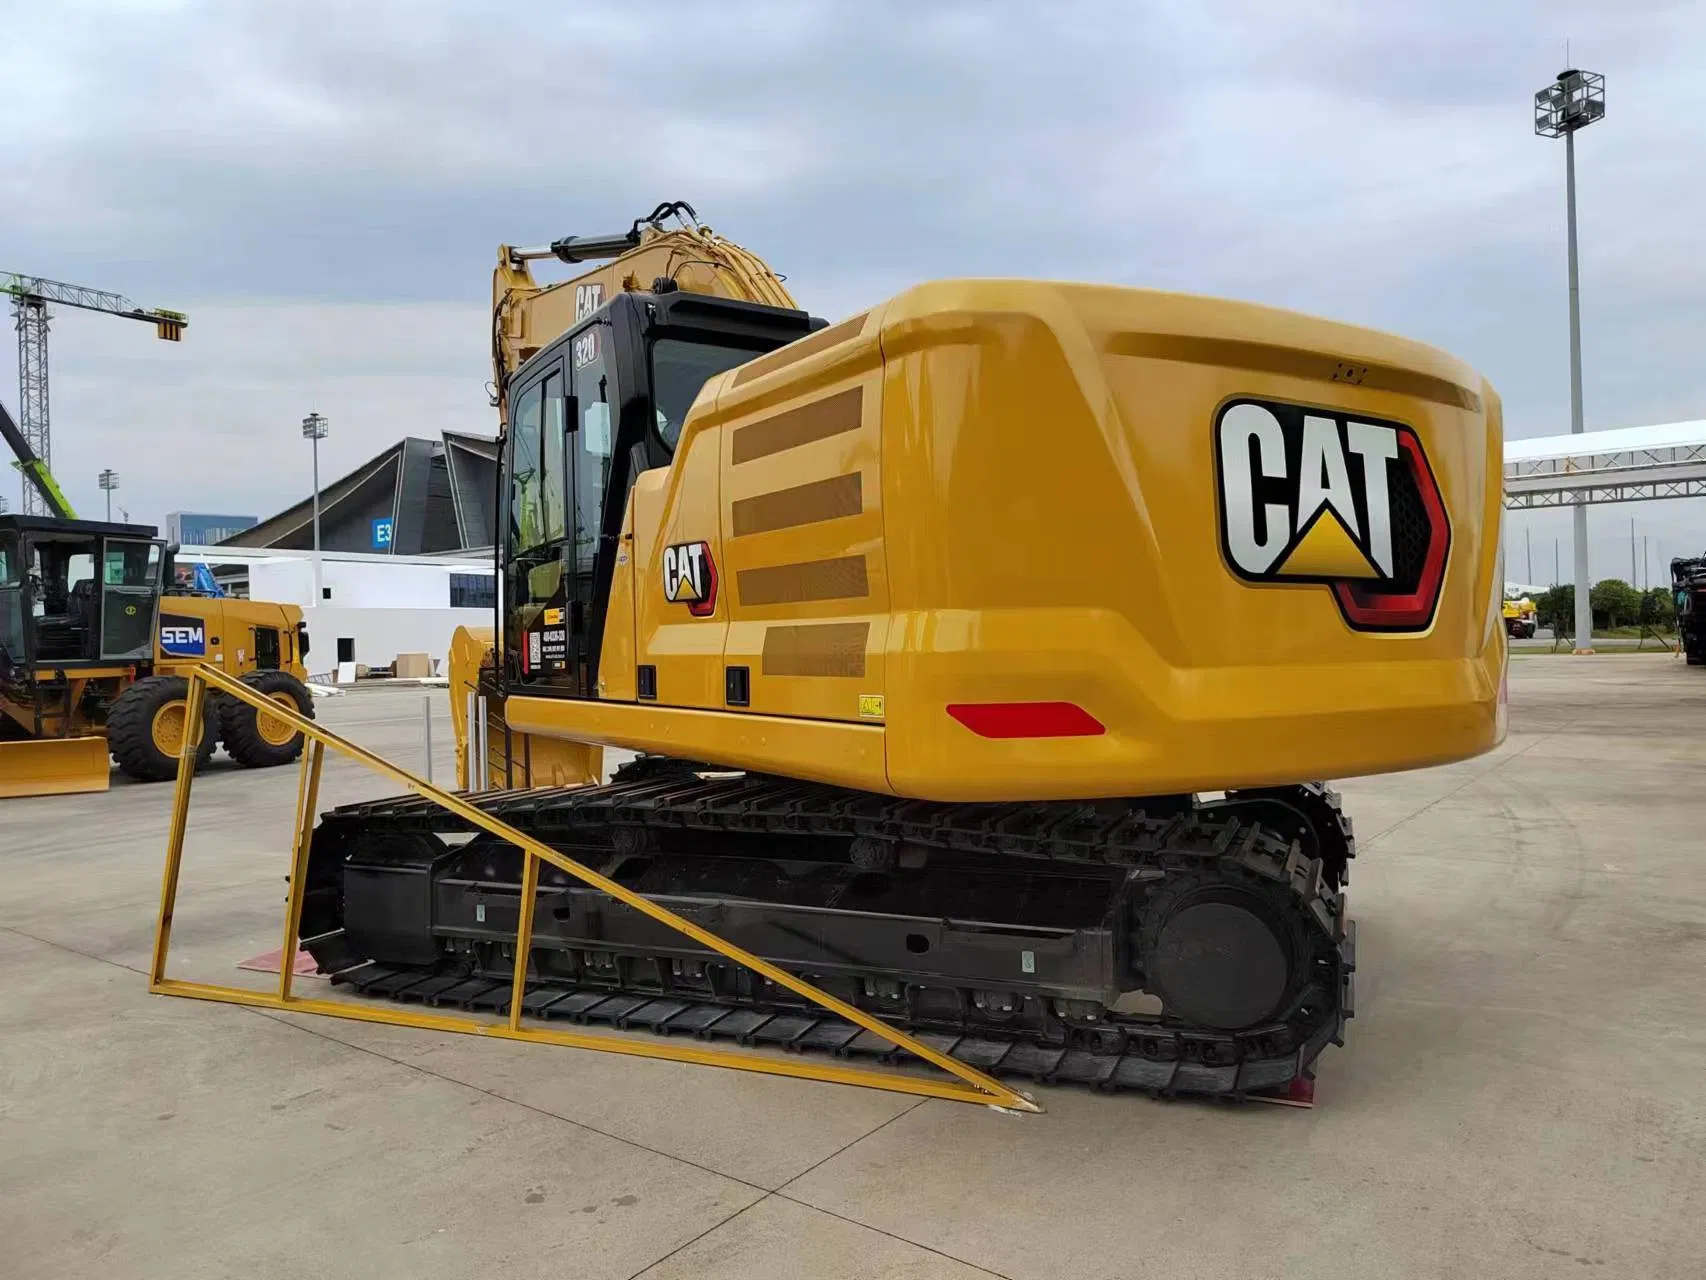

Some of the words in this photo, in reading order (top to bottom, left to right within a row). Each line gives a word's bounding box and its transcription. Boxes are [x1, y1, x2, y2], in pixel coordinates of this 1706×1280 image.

[576, 284, 601, 323] CAT
[576, 333, 595, 367] 320
[1220, 404, 1399, 579] CAT
[377, 524, 392, 542] E3
[664, 543, 702, 600] CAT
[162, 627, 203, 643] SEM
